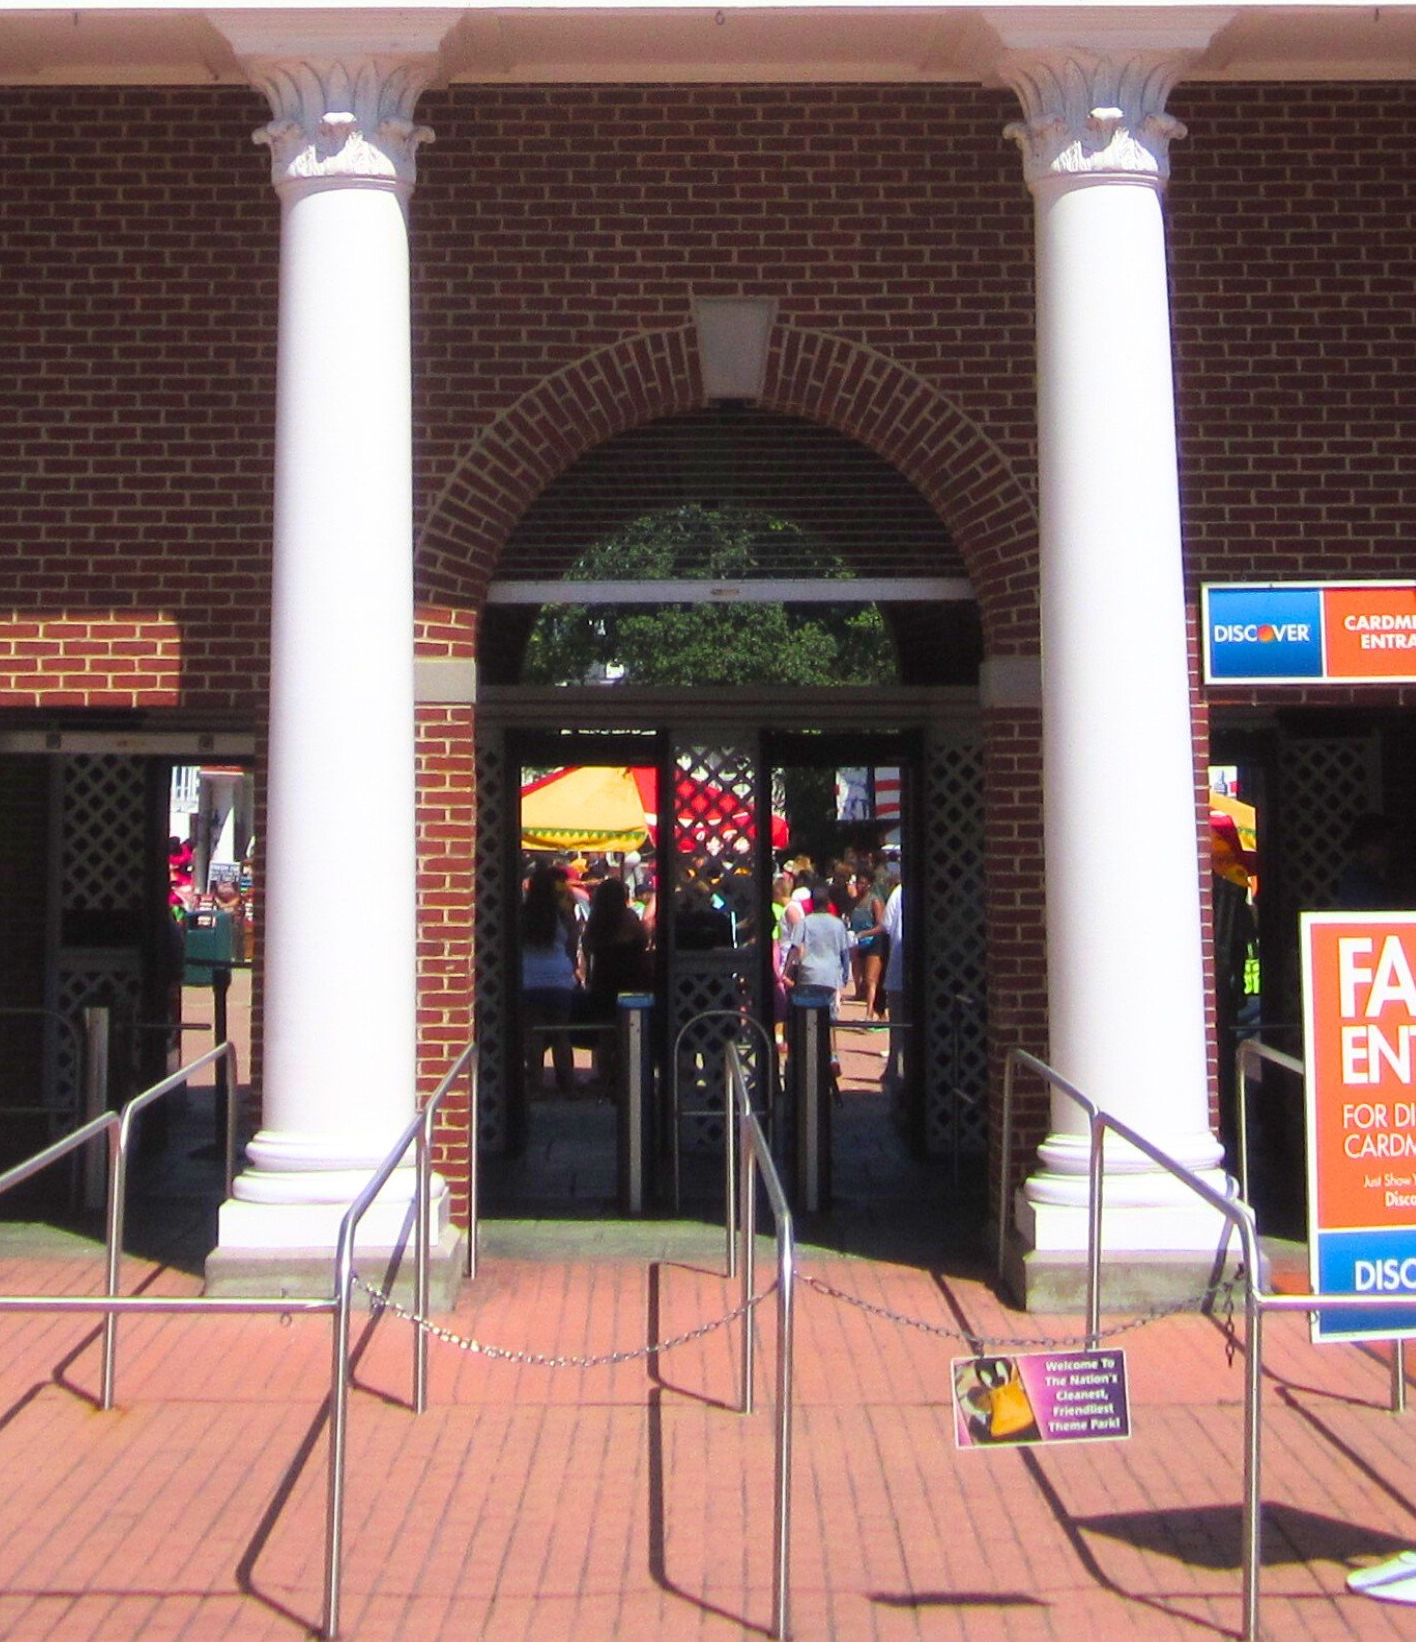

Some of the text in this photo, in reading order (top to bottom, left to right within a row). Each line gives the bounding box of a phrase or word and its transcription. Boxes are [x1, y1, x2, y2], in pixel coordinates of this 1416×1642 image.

[1214, 623, 1311, 642] DISCOVER
[1343, 1103, 1387, 1128] FOR
[1364, 1174, 1382, 1188] Just
[1384, 1171, 1411, 1187] Show
[1045, 1358, 1115, 1372] Welcome To
[1045, 1373, 1118, 1386] The Nation's
[1053, 1403, 1114, 1416] Friendliest
[1048, 1418, 1120, 1432] Theme Park!
